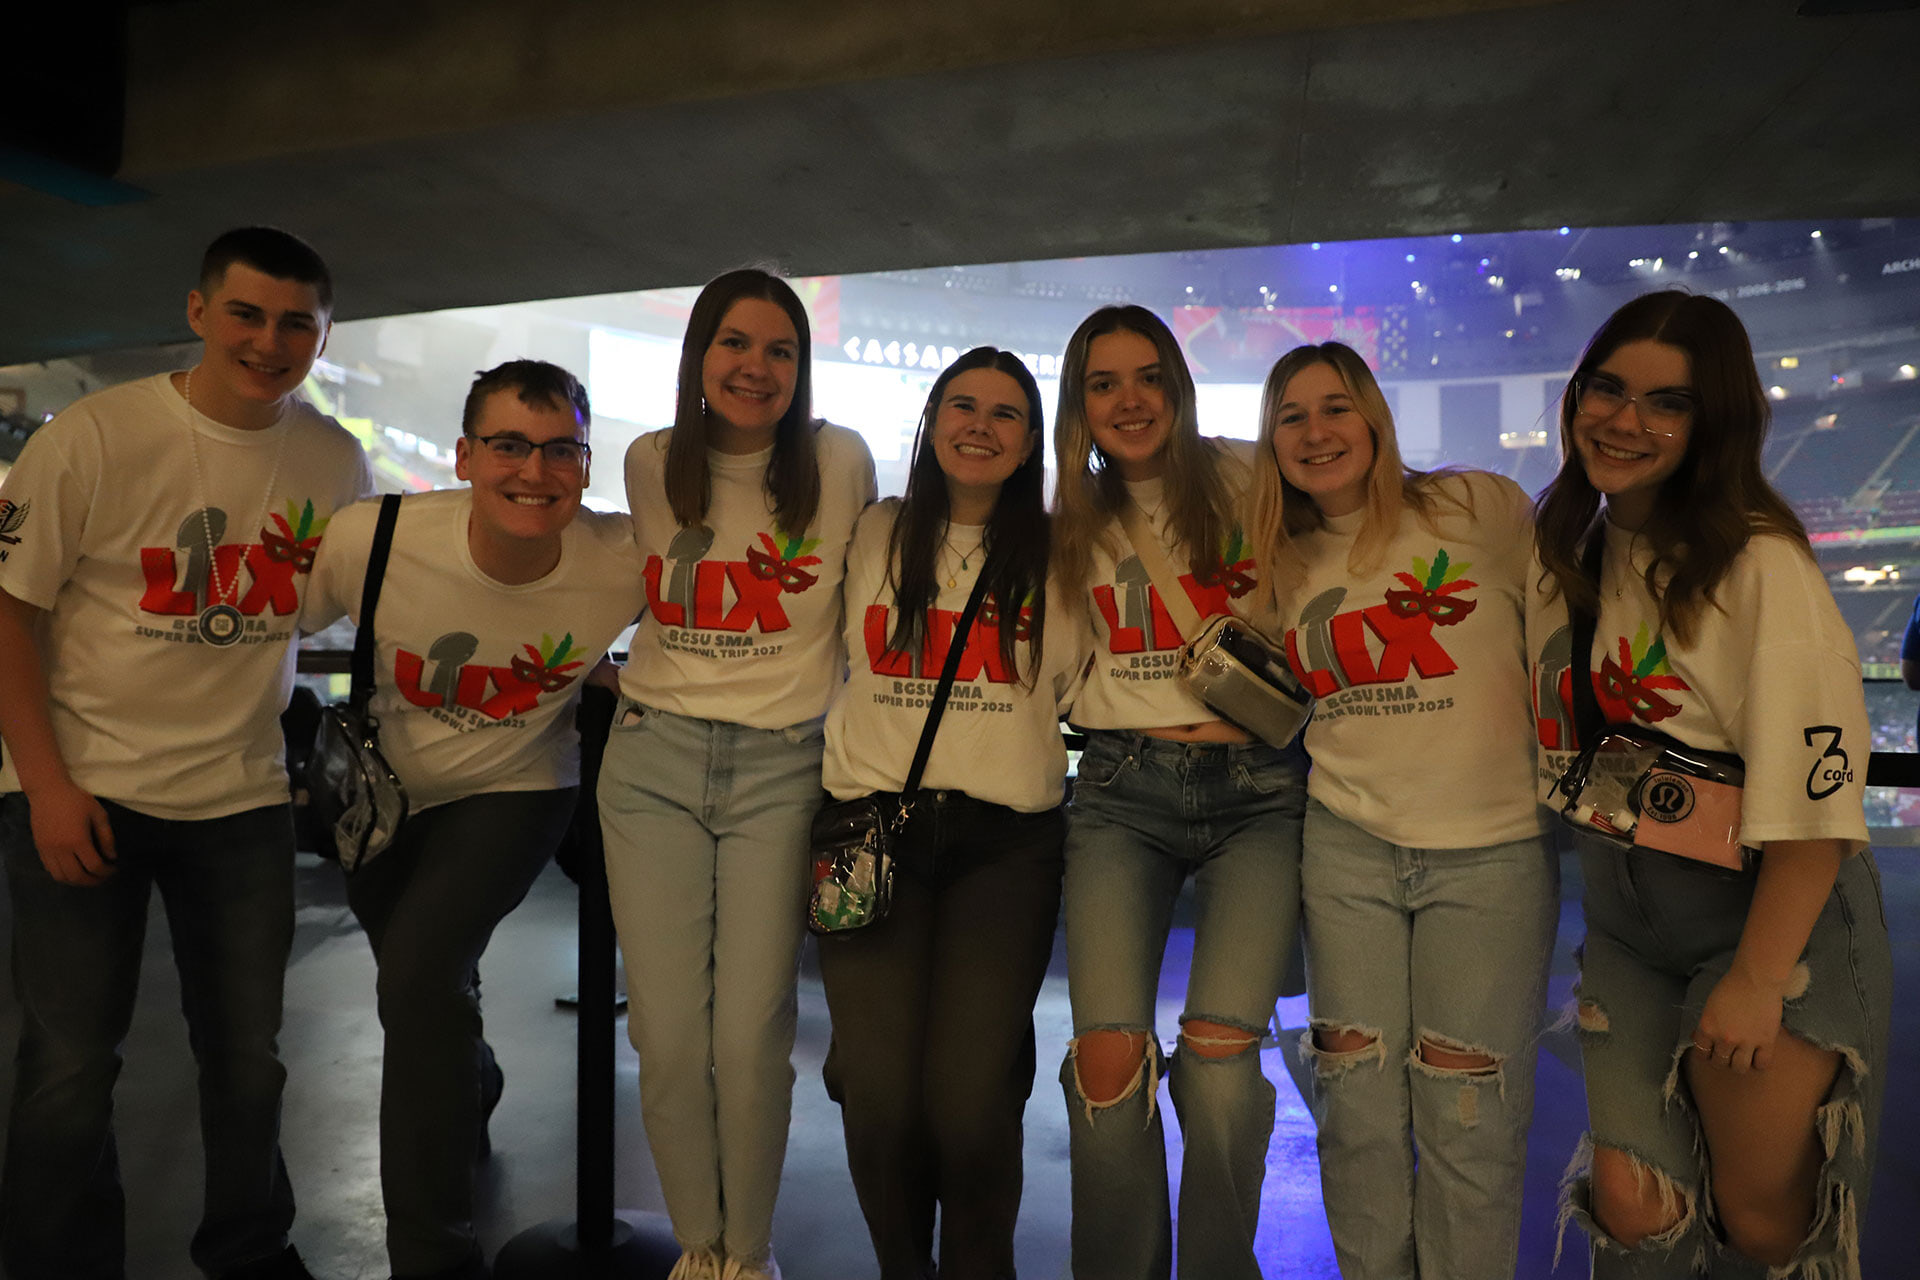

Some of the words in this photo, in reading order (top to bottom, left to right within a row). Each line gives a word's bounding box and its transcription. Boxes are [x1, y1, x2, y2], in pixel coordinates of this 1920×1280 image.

[843, 336, 974, 369] CAESAR
[642, 555, 791, 633] LIX
[134, 625, 183, 642] SUPER
[172, 619, 198, 631] BG
[669, 629, 712, 646] BGSU
[714, 634, 754, 647] SMA
[719, 648, 750, 659] TRIP
[1129, 654, 1175, 669] BGSU
[1142, 669, 1175, 681] BOW
[947, 685, 983, 699] MA
[1325, 688, 1373, 709] BGSU
[1376, 685, 1419, 702] SMA
[873, 693, 903, 707] SUPER
[948, 700, 979, 712] TRIP
[981, 702, 1013, 713] 2025
[1346, 704, 1381, 717] BOWL
[1382, 703, 1416, 716] TRIP
[1418, 697, 1454, 713] 2025
[432, 708, 465, 733] BOWL
